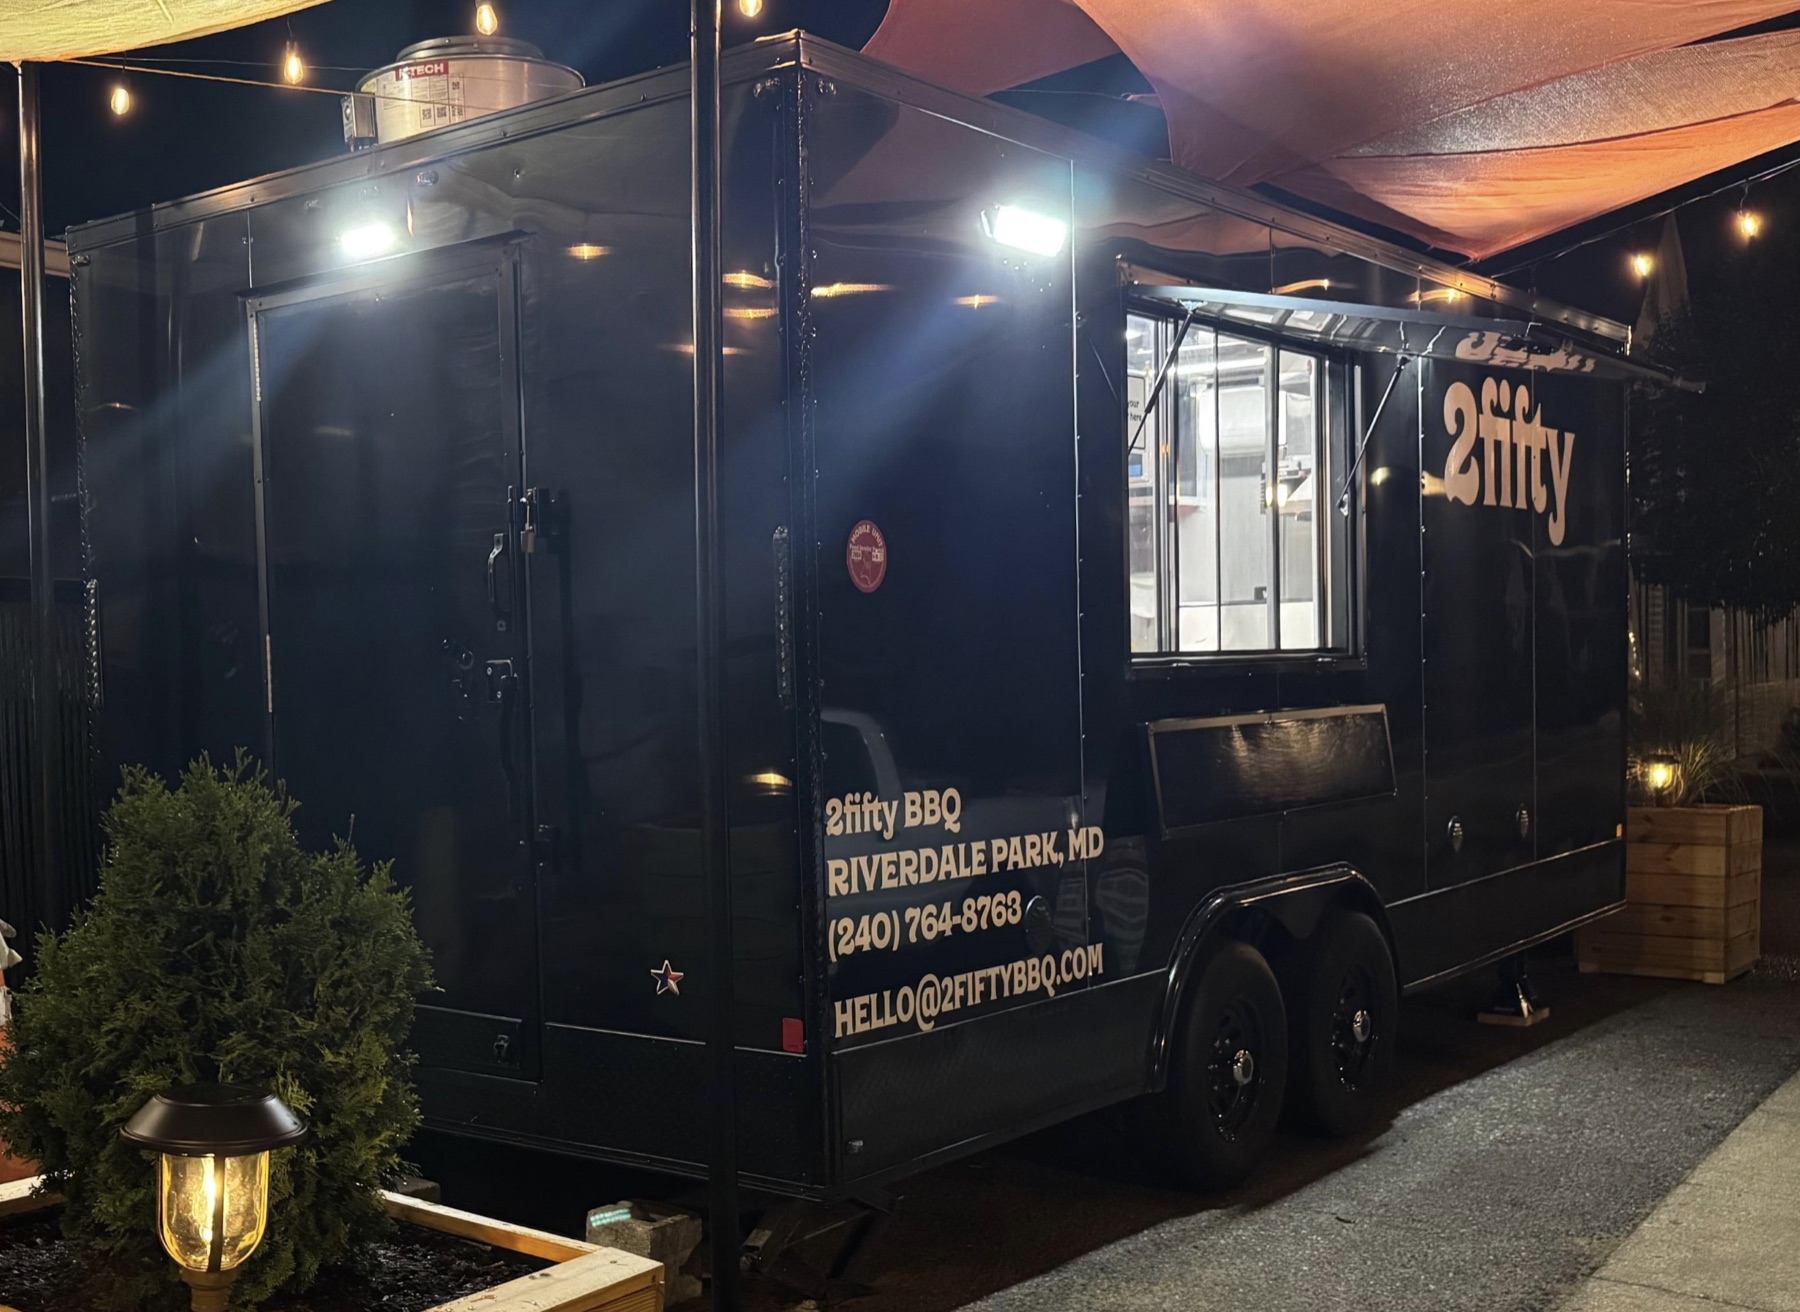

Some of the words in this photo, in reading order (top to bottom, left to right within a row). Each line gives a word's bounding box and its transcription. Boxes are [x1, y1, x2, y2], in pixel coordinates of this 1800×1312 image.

[1443, 376, 1576, 546] 2fifty
[851, 524, 871, 544] MOBILE
[872, 527, 883, 547] UNIT
[825, 791, 899, 840] 2fifty
[904, 787, 962, 833] BBQ
[827, 841, 987, 897] RIVERDALE
[990, 831, 1065, 873] PARK,
[1068, 826, 1104, 861] MD
[828, 910, 900, 963] (240)
[905, 890, 1022, 943] 764-8763
[834, 943, 1104, 1038] HELLO@2FIFTYBBQ.COM
